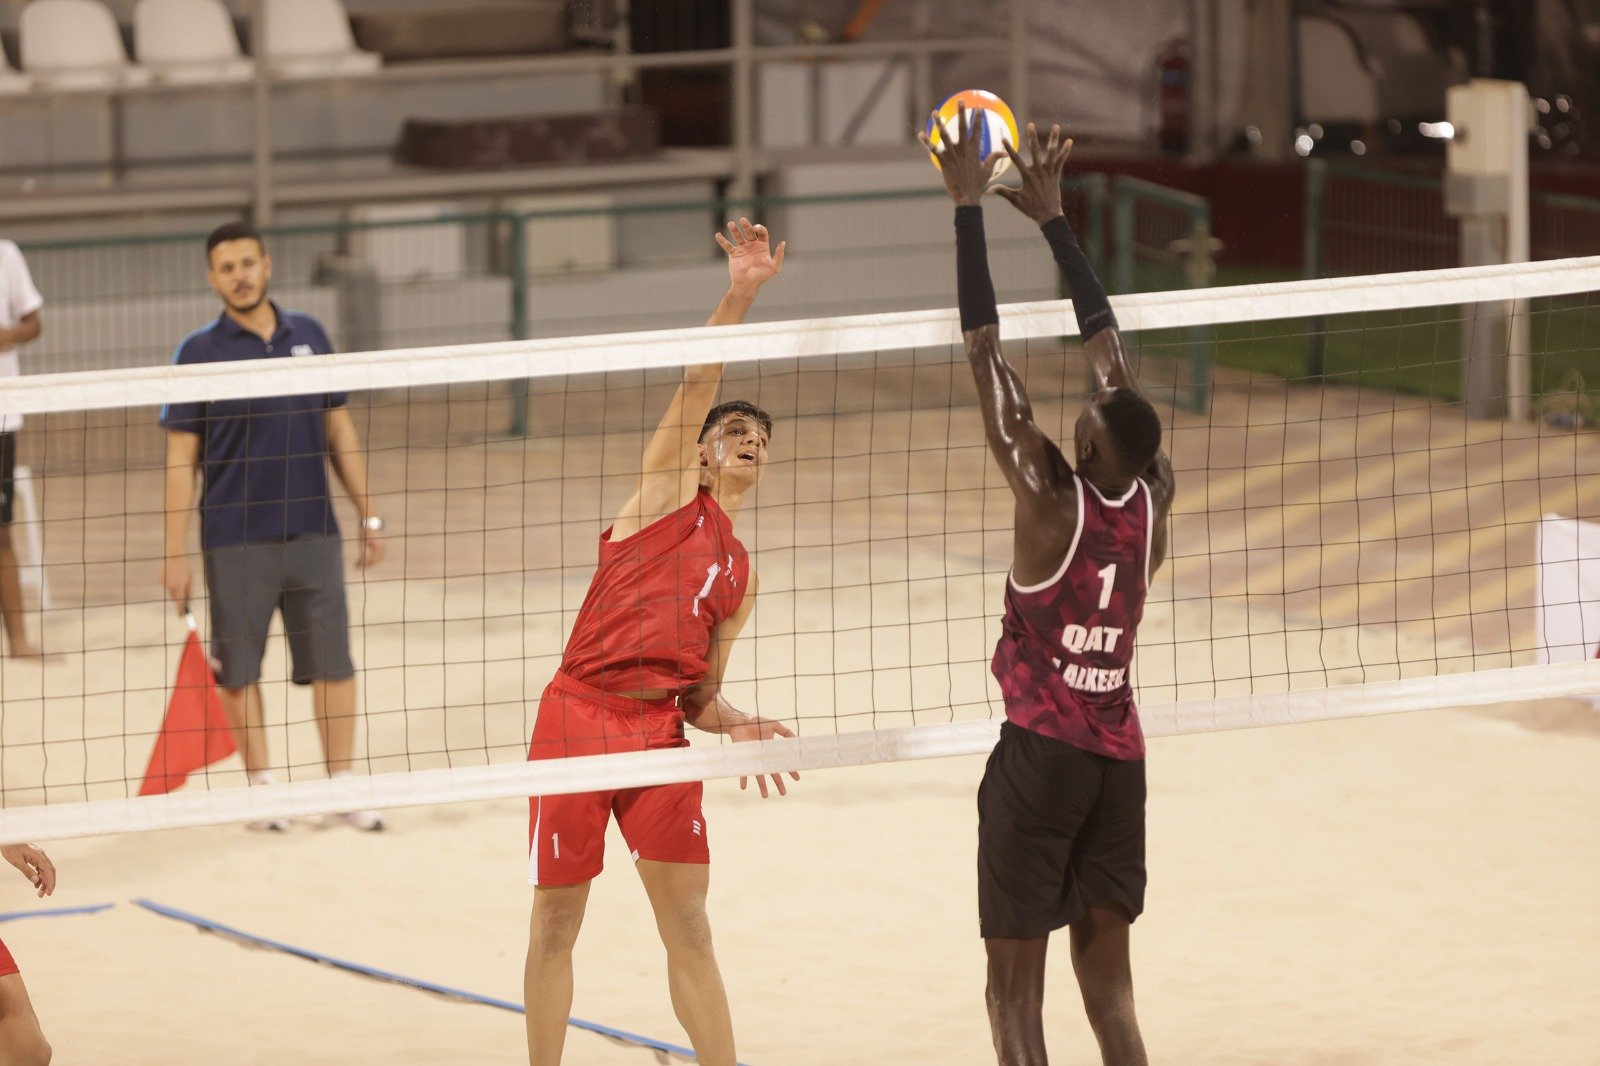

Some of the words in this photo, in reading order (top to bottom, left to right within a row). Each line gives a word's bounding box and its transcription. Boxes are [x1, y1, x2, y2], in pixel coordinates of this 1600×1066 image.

[692, 562, 721, 617] 1
[1098, 563, 1117, 609] 1
[1062, 623, 1123, 654] QAT
[552, 832, 560, 859] 1
